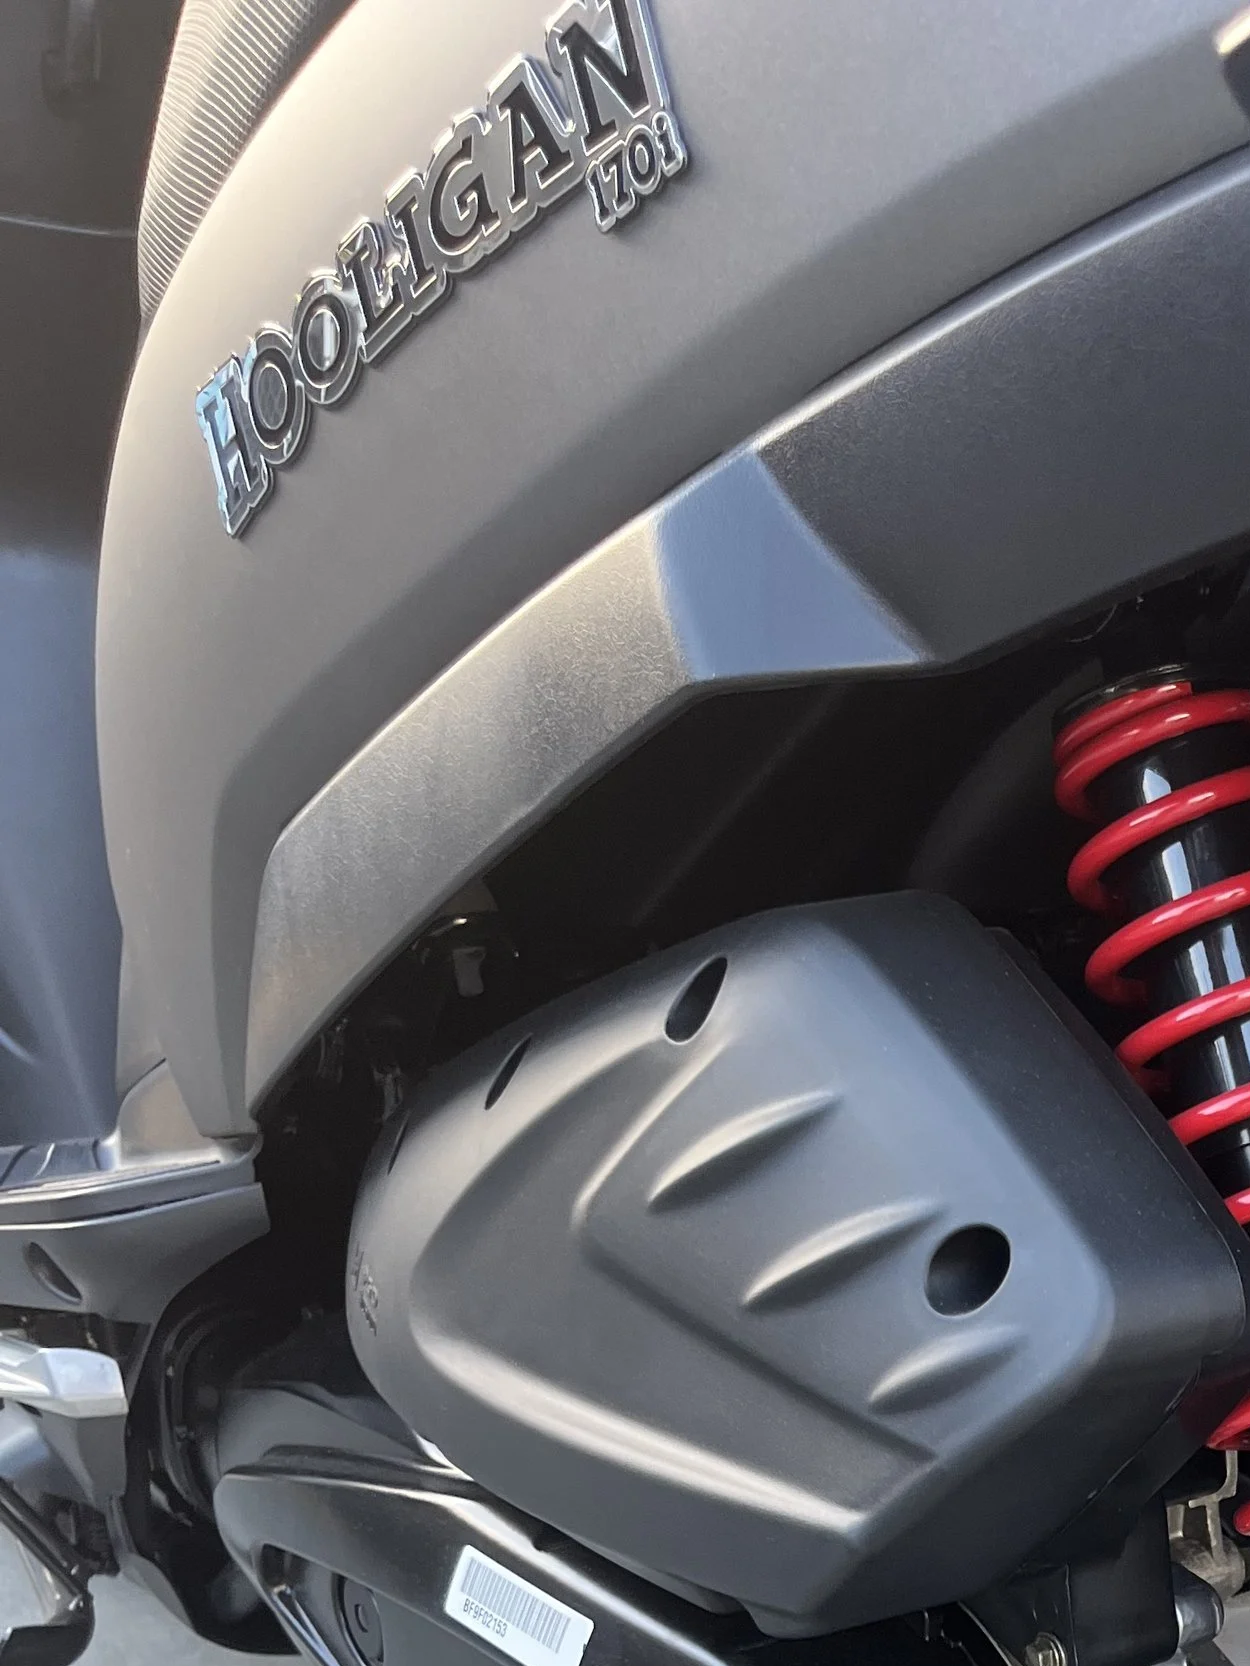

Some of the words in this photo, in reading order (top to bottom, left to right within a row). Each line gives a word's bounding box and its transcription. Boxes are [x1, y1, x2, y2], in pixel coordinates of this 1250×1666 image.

[584, 110, 688, 233] 170i
[195, 0, 670, 537] HOOLIGAN
[462, 1597, 508, 1638] BF9F02153
